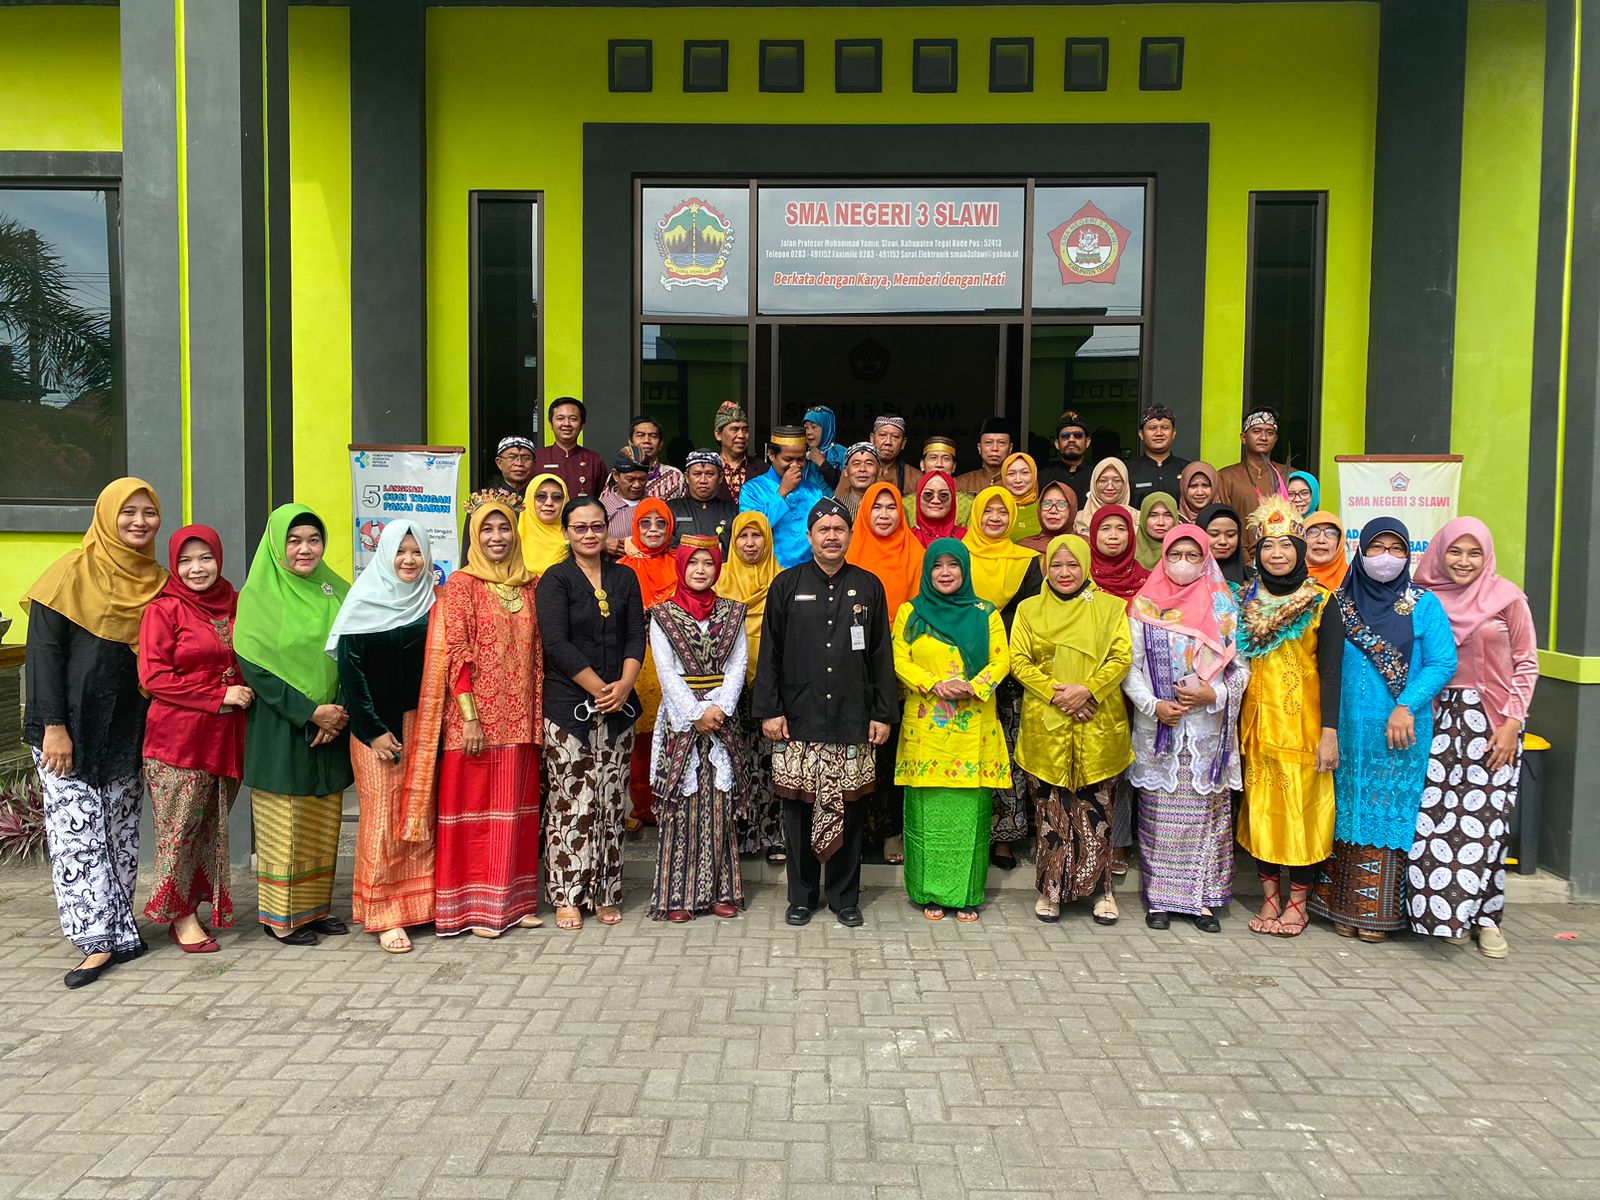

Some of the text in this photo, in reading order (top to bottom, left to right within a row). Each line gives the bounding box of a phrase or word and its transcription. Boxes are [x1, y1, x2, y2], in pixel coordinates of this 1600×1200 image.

[785, 201, 999, 228] SMA NEGERI 3 SLAWI
[934, 239, 951, 249] Tegal
[952, 239, 968, 248] Kode
[983, 239, 1002, 248] 52413
[765, 250, 790, 259] Telepon
[774, 271, 1006, 289] Berkata dengan Karya, Memberi dengan Hati
[362, 485, 381, 508] 5
[383, 493, 451, 504] CUCI TANGAN
[1348, 496, 1450, 507] SMA NEGERI 3 SLAWI
[383, 502, 450, 513] PAKAI SABUN
